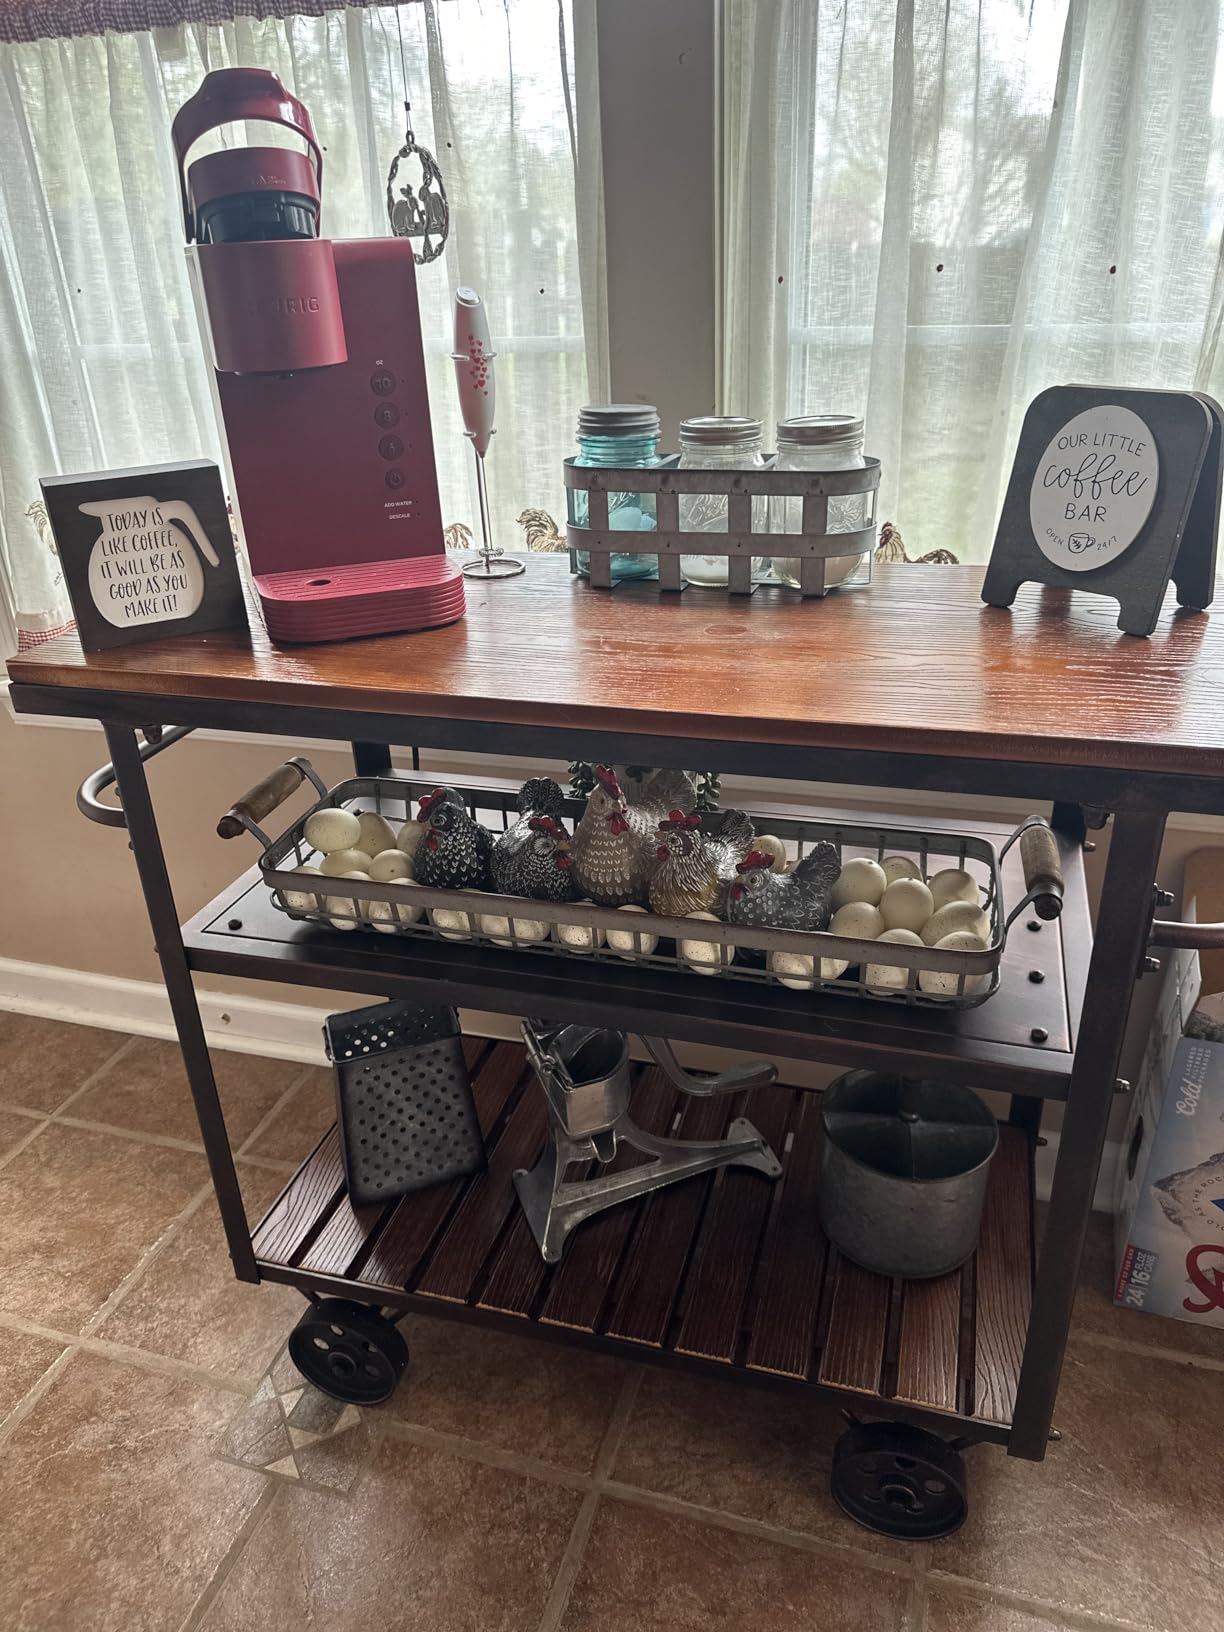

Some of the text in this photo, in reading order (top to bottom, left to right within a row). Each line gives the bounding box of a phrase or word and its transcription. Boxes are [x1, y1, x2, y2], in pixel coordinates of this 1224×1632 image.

[1057, 432, 1148, 457] OUR LITTLE
[1043, 452, 1148, 501] coffee
[106, 507, 164, 532] TODAY IS
[1064, 502, 1107, 522] BAR
[101, 530, 179, 557] LIKE COFFEE,
[1046, 527, 1118, 551] OPEN 24/7
[100, 550, 186, 579] IT WILL BE AS
[109, 574, 189, 600] GOOD AS YOU
[124, 594, 178, 619] MAKE IT!
[1175, 1078, 1202, 1116] Cold
[1200, 1176, 1224, 1188] ROC
[1130, 1270, 1151, 1285] 16
[1126, 1288, 1145, 1306] 24
